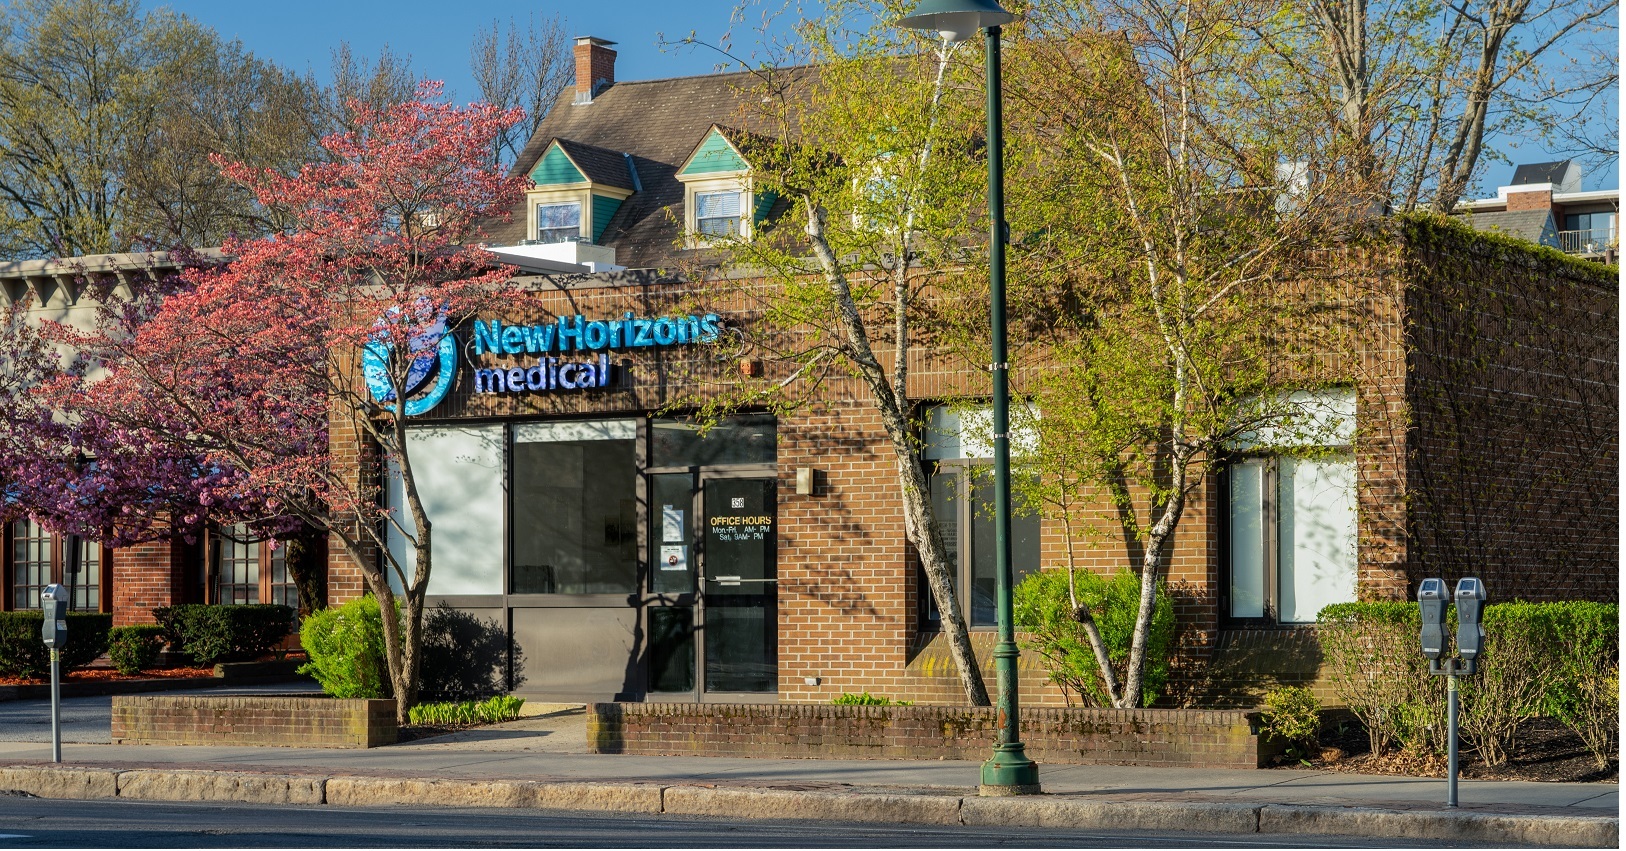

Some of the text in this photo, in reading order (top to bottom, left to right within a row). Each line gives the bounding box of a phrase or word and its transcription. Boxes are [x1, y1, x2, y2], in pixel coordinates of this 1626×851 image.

[474, 311, 720, 355] New Horizons
[475, 353, 610, 393] medical
[731, 497, 744, 508] 358
[710, 515, 772, 526] OFFICE HOURS
[759, 525, 770, 533] PM
[753, 532, 764, 540] PM
